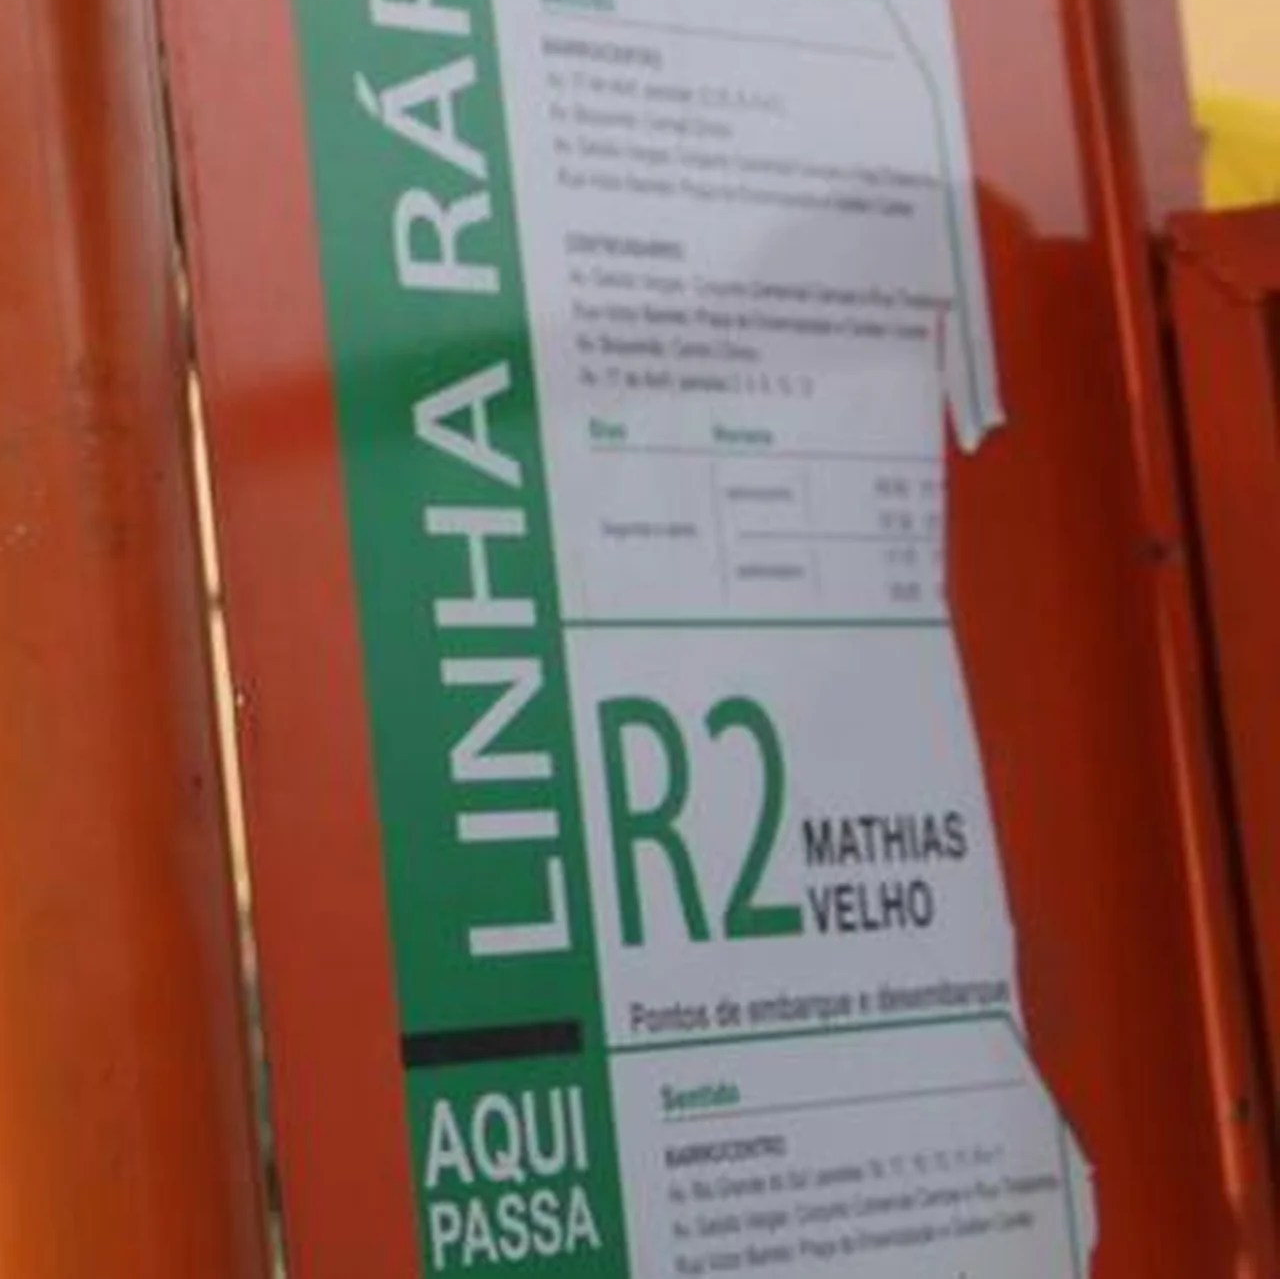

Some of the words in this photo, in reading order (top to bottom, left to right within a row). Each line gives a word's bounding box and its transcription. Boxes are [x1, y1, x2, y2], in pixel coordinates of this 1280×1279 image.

[412, 360, 572, 956] LINHA
[596, 695, 805, 948] R2
[802, 811, 969, 868] MATHIAS
[808, 880, 936, 935] VELHO
[629, 998, 711, 1034] Pontos
[715, 994, 741, 1028] de
[747, 992, 852, 1034] embarque
[425, 1085, 590, 1189] AQUI
[430, 1186, 603, 1270] PASSA
